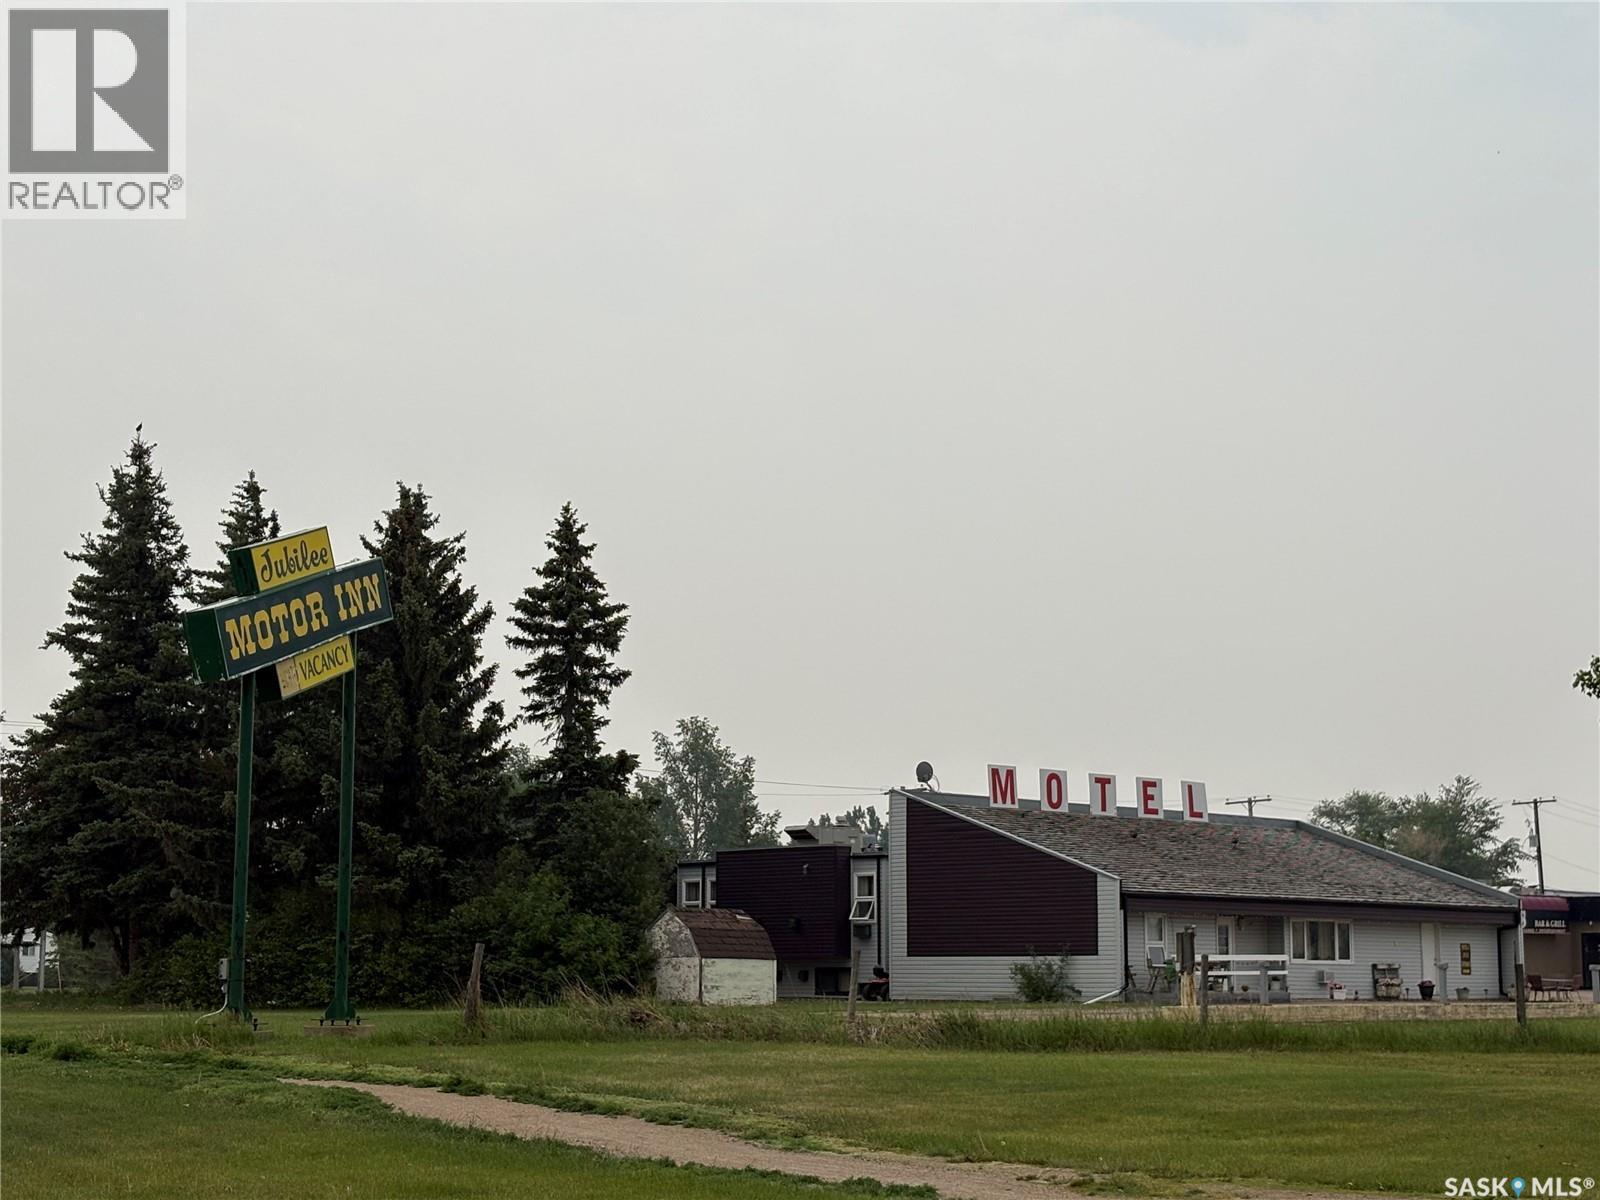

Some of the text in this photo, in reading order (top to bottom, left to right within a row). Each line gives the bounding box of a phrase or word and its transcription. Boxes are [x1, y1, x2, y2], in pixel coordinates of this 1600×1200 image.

[260, 540, 328, 583] Jubilee
[224, 573, 382, 661] MOTOR INN
[299, 643, 349, 681] VACANCY
[991, 767, 1204, 819] MOTEL
